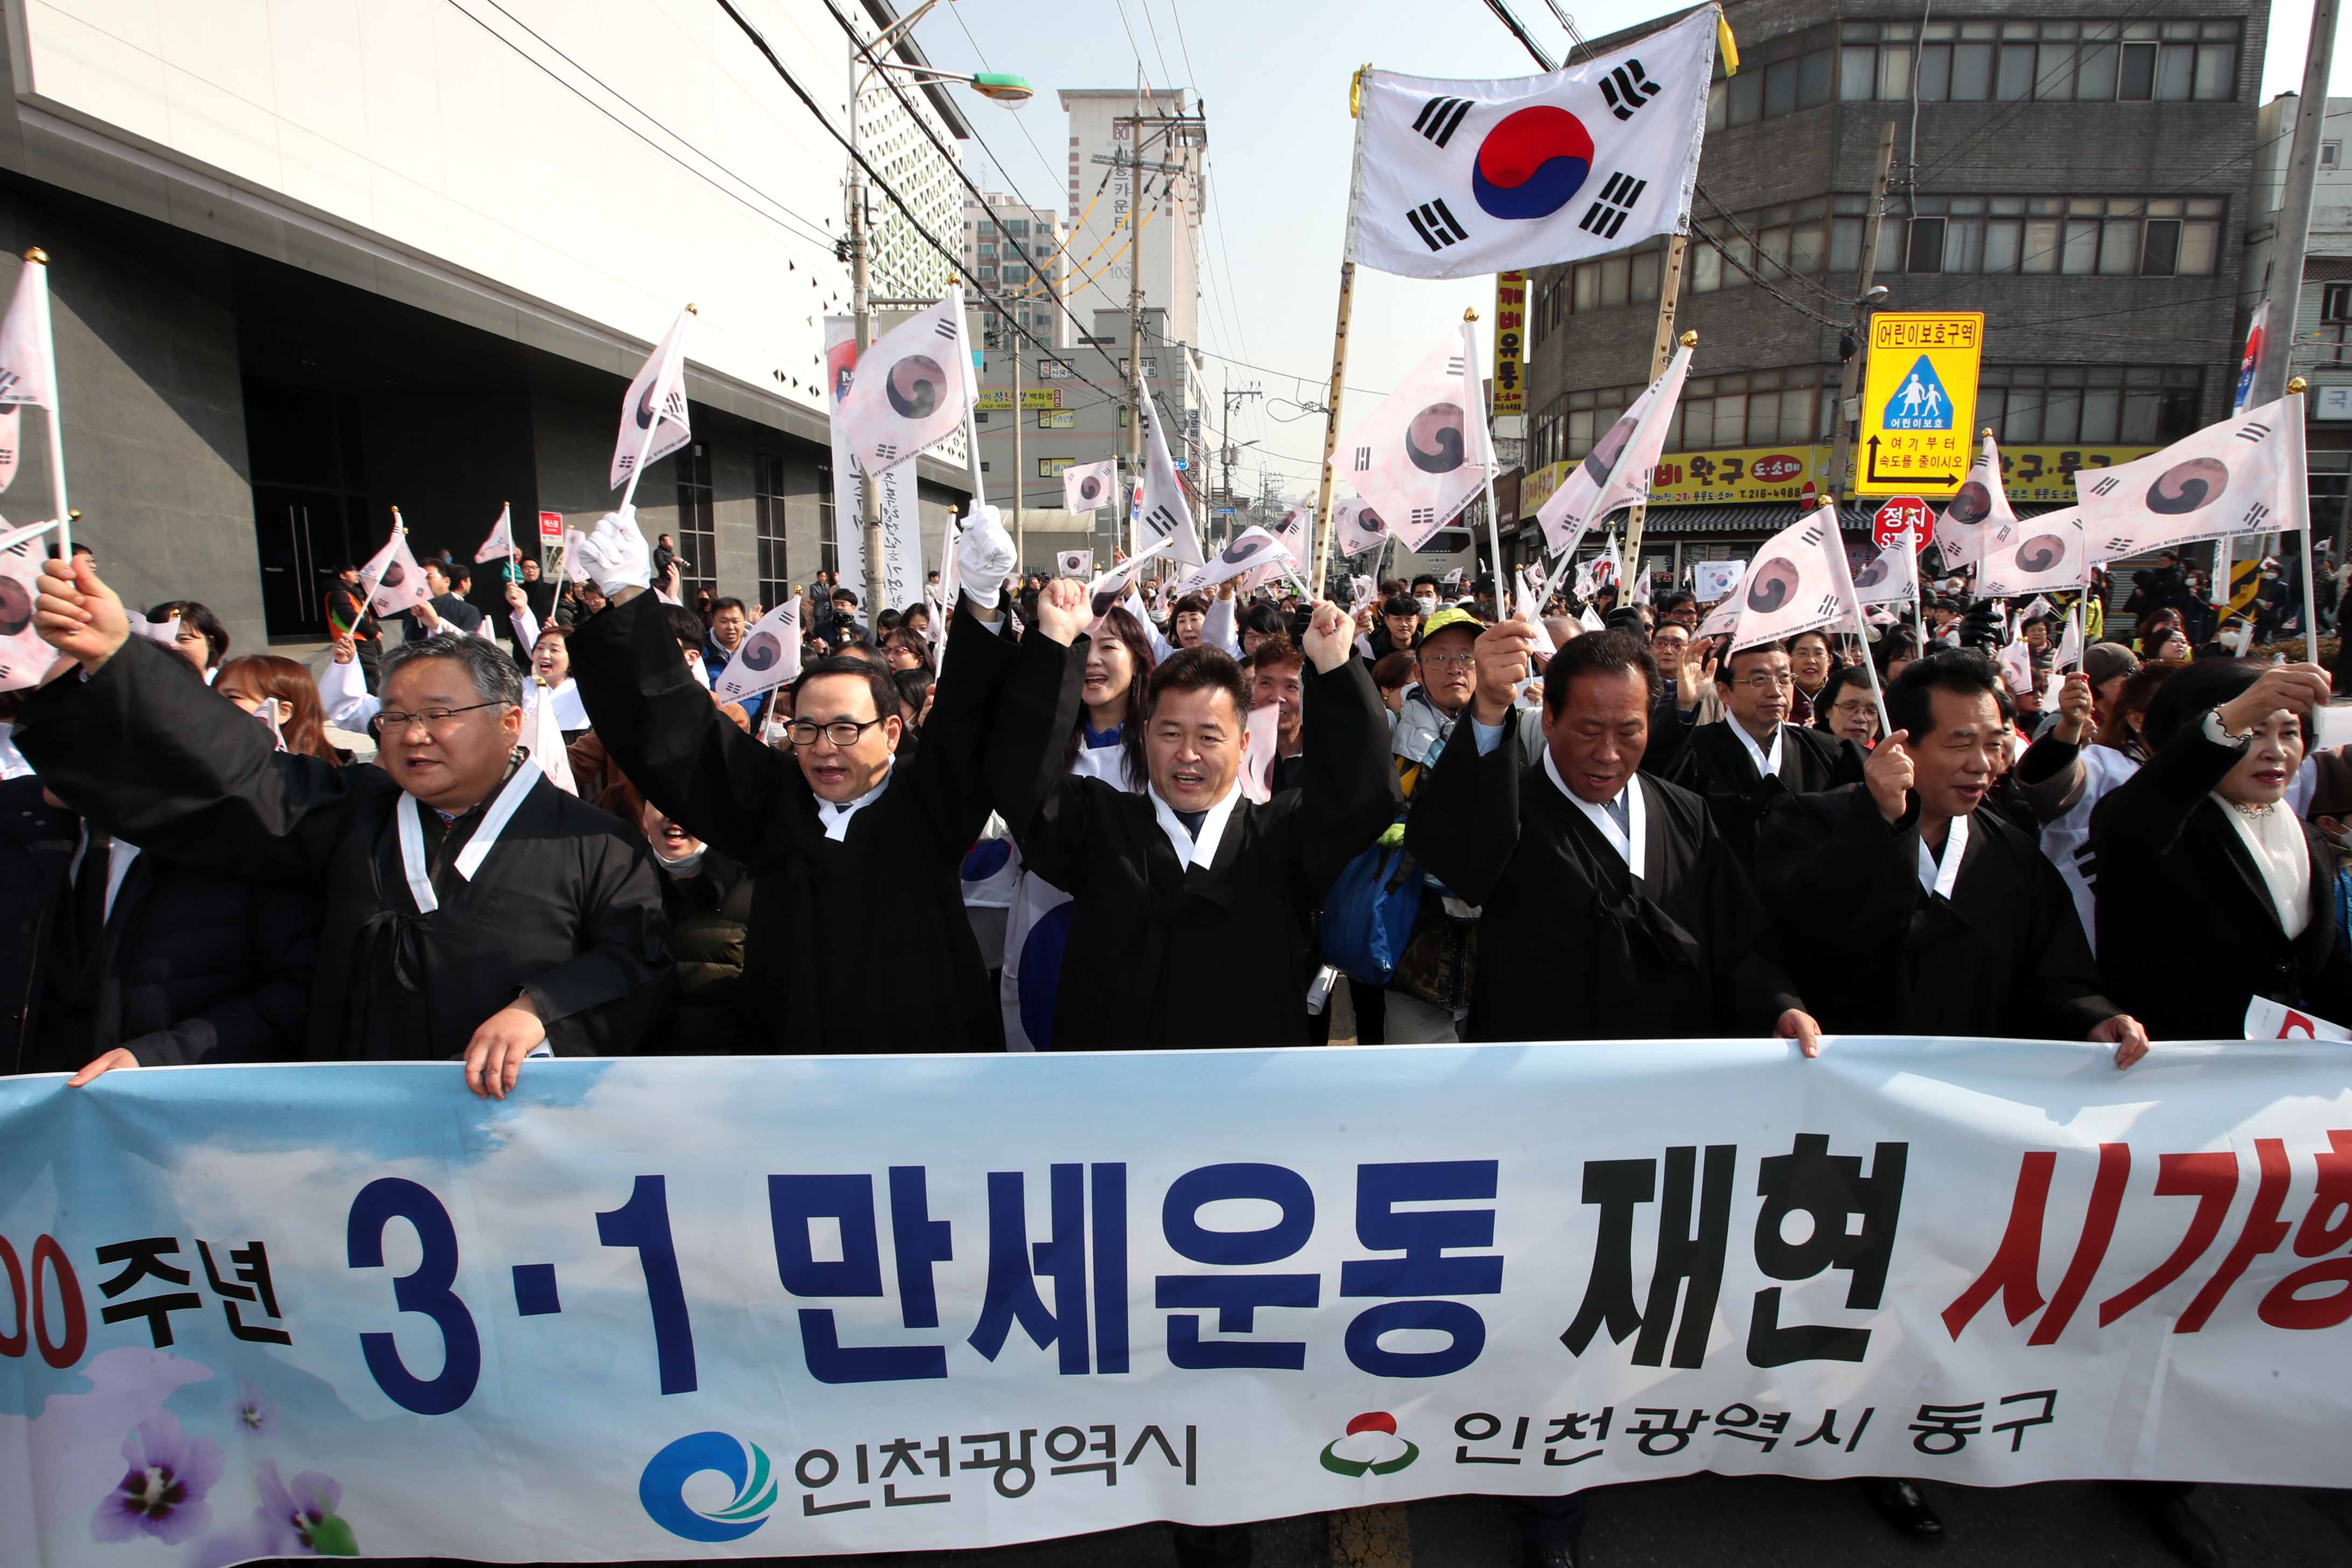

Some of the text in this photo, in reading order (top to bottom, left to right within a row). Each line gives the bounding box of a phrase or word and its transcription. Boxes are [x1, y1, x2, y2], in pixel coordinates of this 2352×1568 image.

[1880, 323, 1973, 345] 어린이보호구역
[1891, 418, 1943, 429] 어린이보호
[1690, 456, 1744, 486] 완구
[1879, 455, 1963, 468] 속도를 줄이시오
[1883, 506, 1926, 528] 정지
[1880, 533, 1924, 549] STP
[767, 1159, 1504, 1384] 만세운동
[1559, 1132, 1909, 1369] 재현
[1453, 1388, 2058, 1466] 인천광역시 동구
[794, 1423, 1197, 1516] 인천광역시
